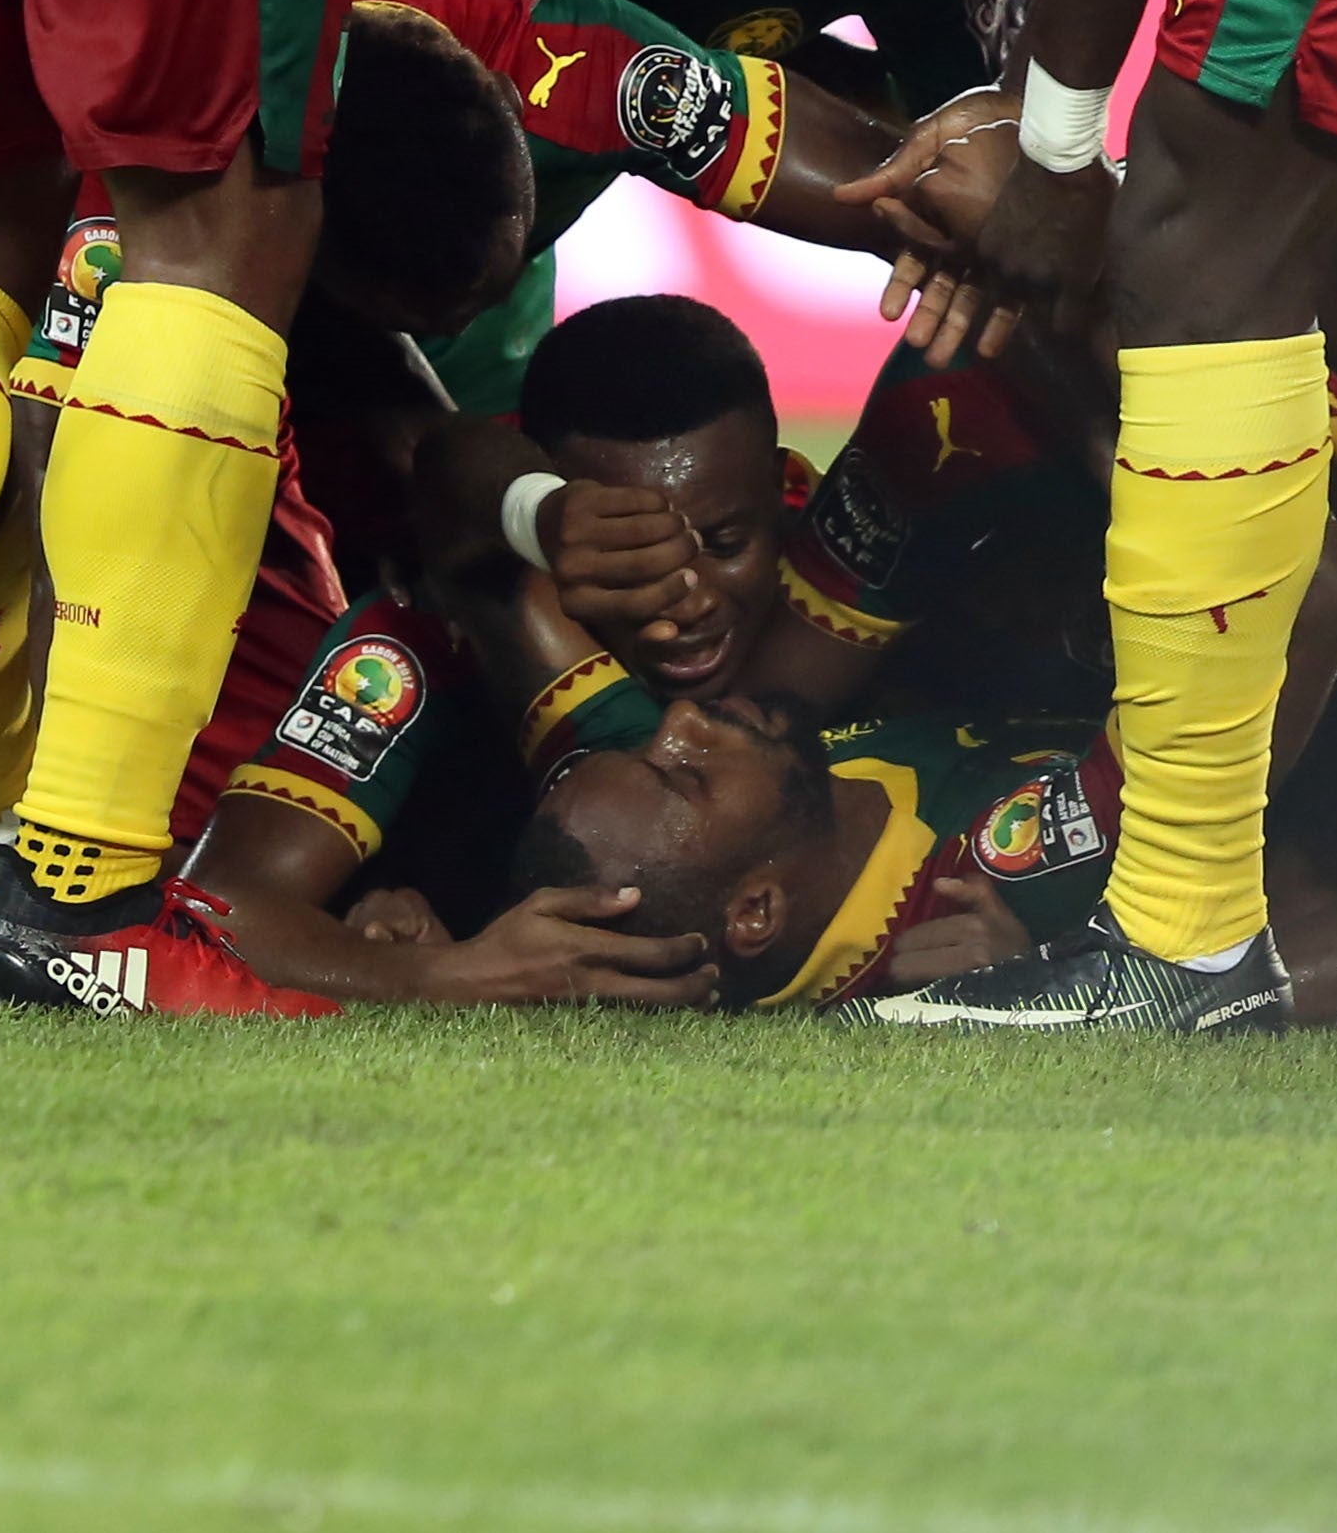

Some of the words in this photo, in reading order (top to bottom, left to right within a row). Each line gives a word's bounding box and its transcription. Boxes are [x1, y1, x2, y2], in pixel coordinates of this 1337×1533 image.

[688, 100, 732, 158] CAF
[54, 600, 101, 628] EROON
[361, 645, 401, 663] GABON
[46, 957, 130, 1021] adid
[1195, 989, 1280, 1032] MERCURIAL
